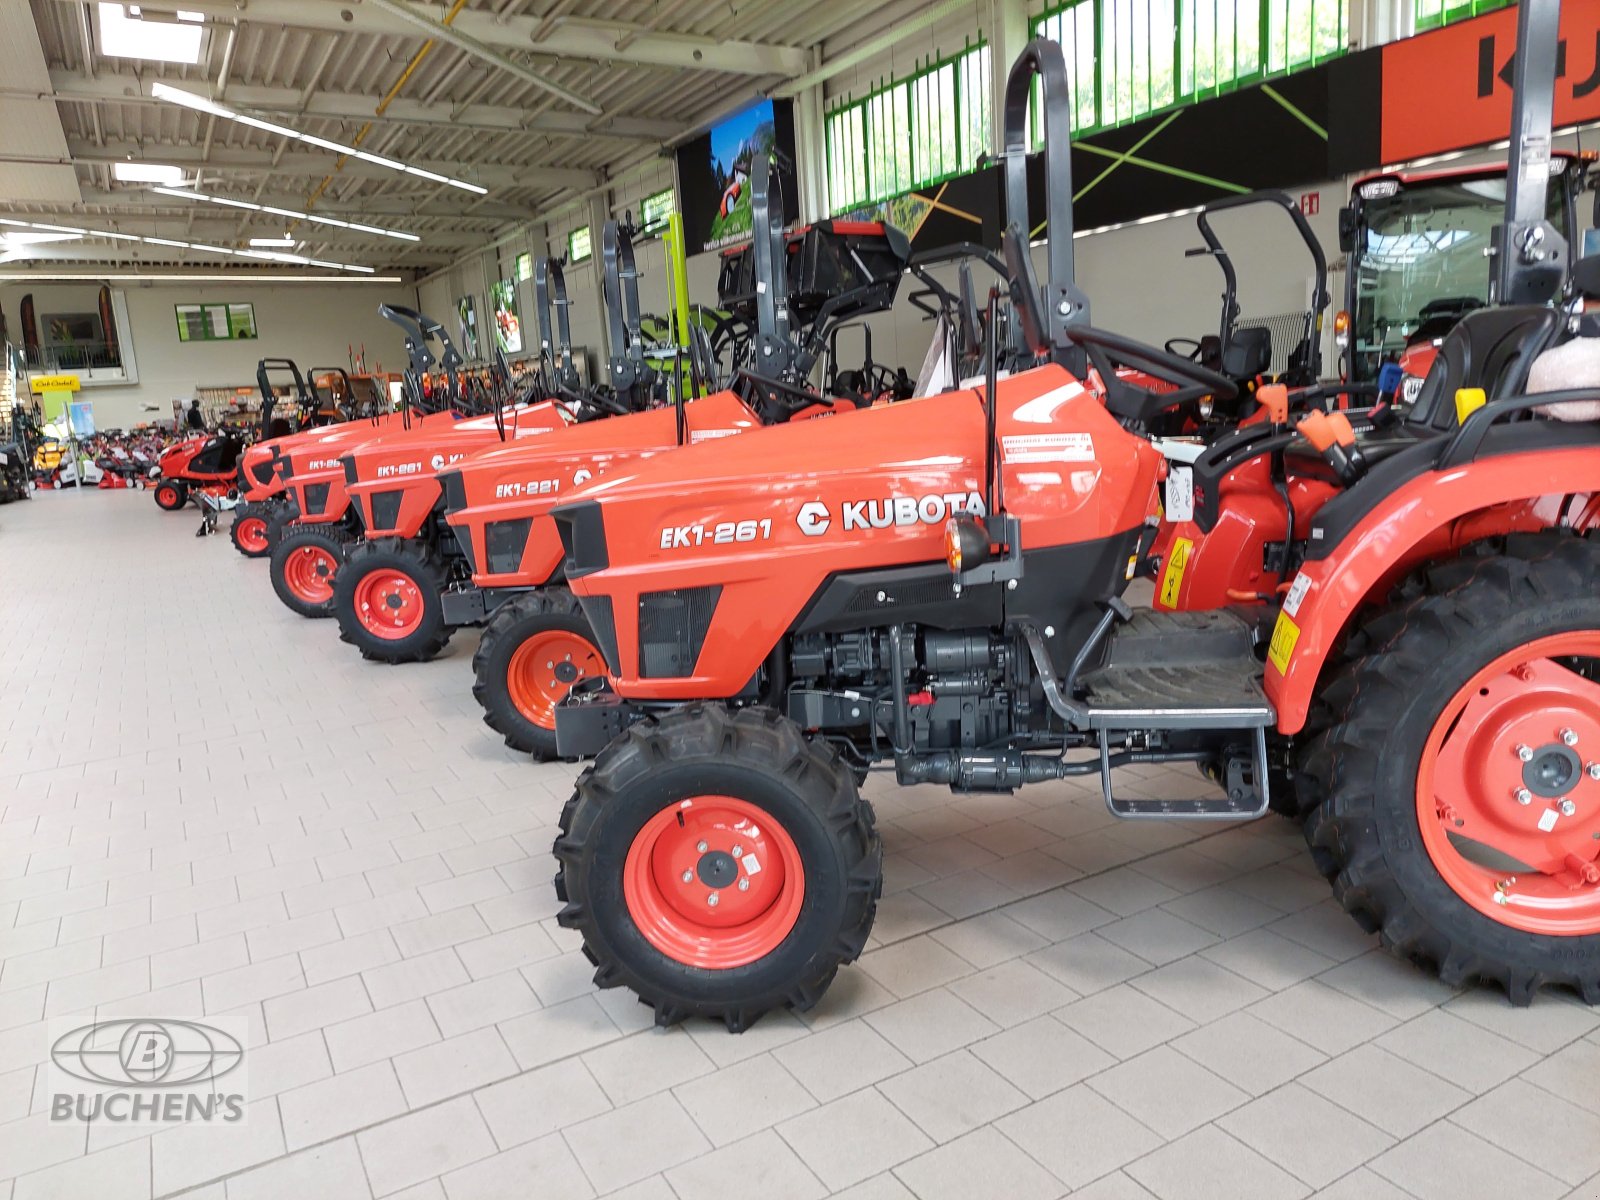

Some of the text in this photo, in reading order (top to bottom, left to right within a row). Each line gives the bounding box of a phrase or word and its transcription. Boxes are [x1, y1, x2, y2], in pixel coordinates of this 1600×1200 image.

[495, 479, 560, 498] EK1-221
[842, 491, 986, 531] KUBOTA
[660, 517, 772, 549] EK1-261
